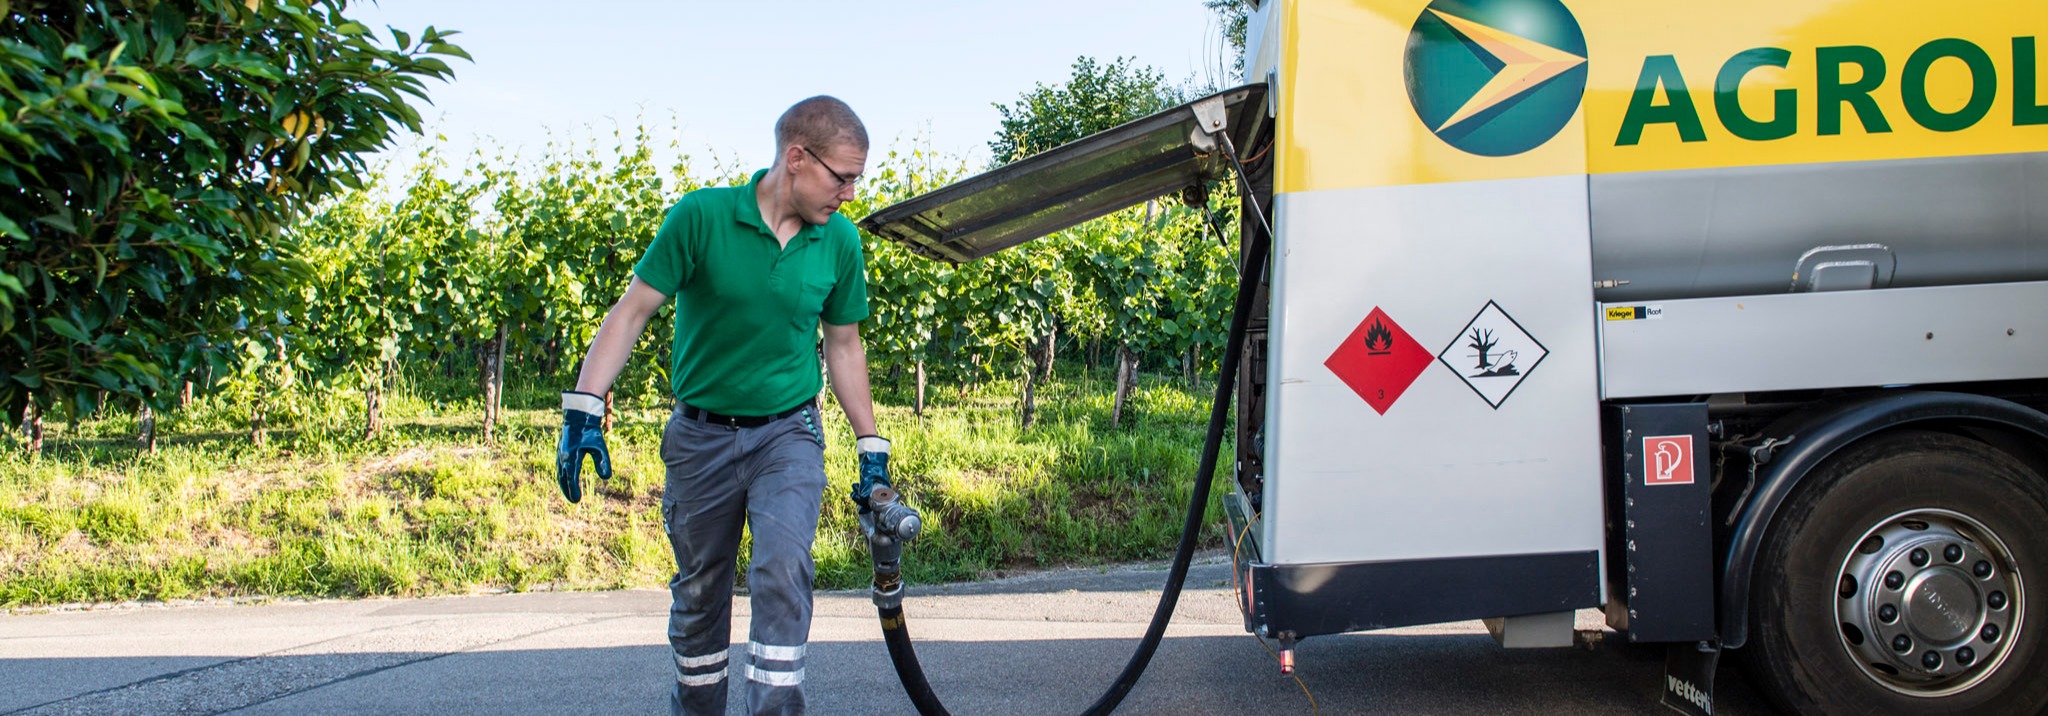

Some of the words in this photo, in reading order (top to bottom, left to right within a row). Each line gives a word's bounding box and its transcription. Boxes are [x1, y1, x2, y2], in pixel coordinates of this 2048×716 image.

[1614, 36, 2048, 146] AGROL
[1608, 310, 1632, 319] Krieger
[1378, 388, 1385, 400] 3
[1668, 674, 1711, 715] vetterli
